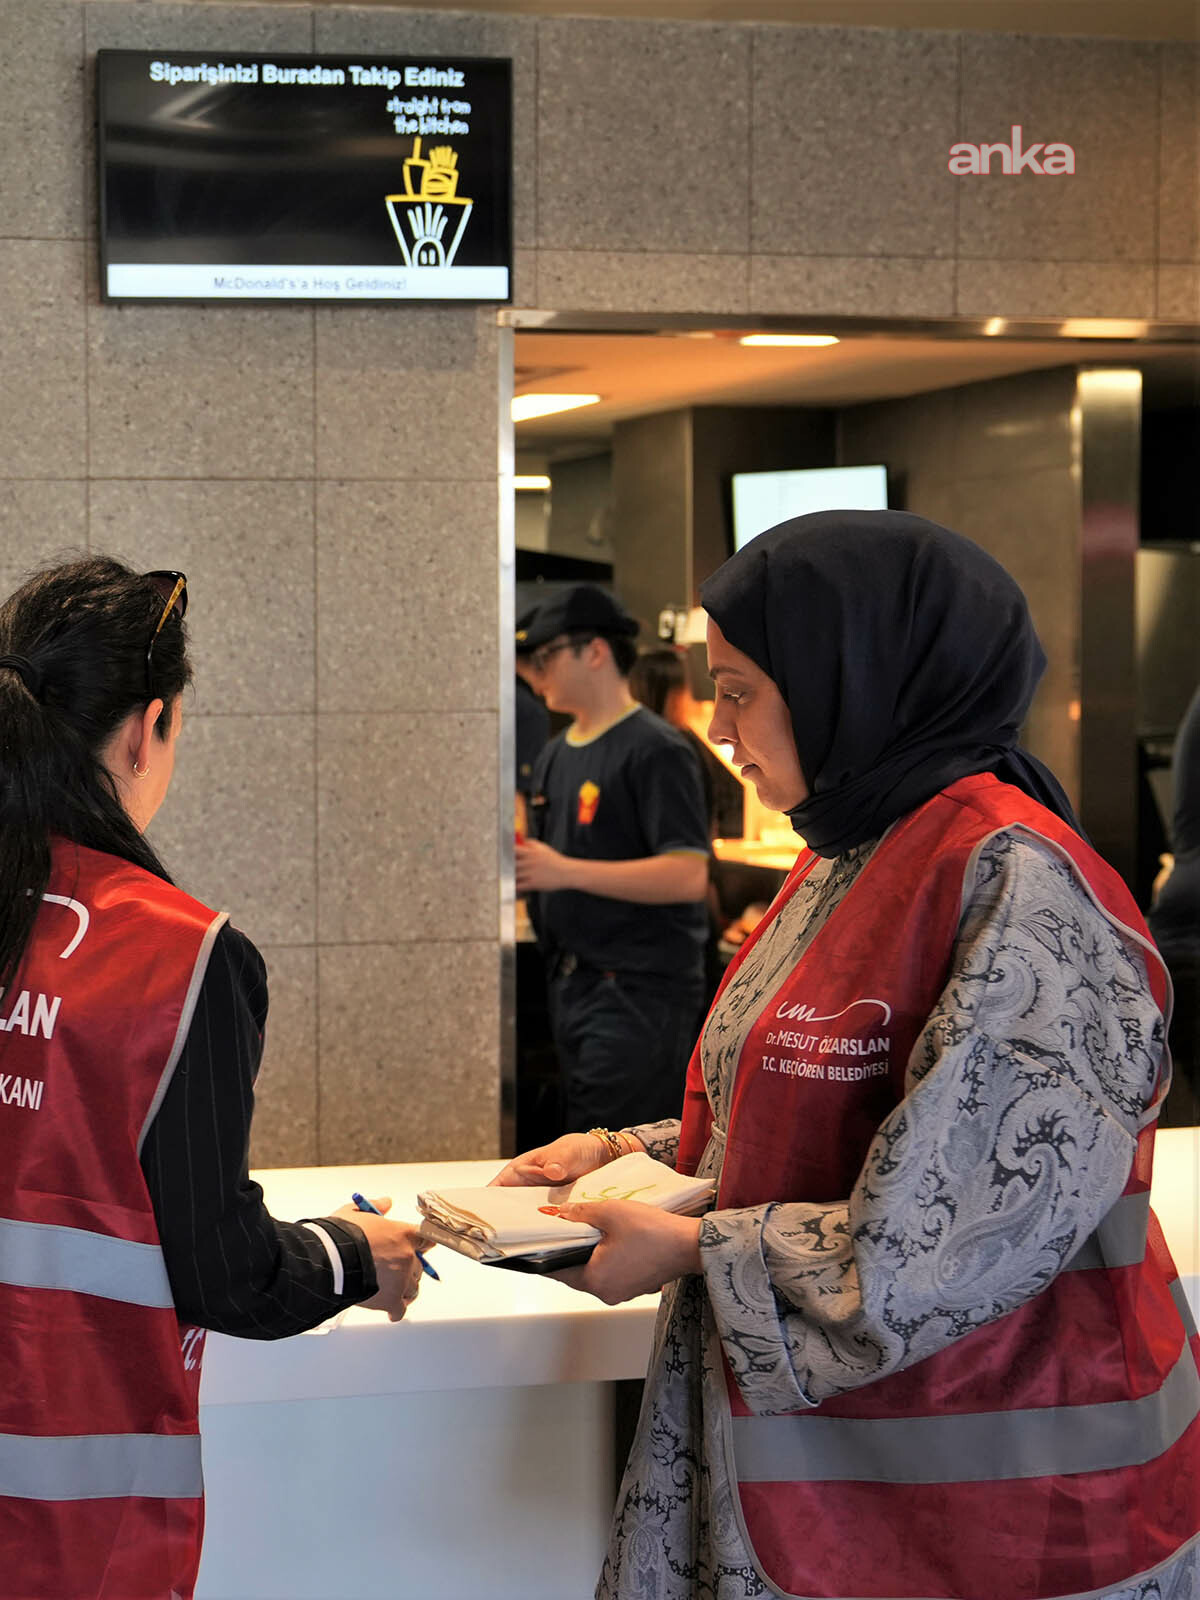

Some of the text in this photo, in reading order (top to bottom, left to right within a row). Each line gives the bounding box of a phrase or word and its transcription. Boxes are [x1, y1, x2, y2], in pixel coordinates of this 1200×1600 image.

[149, 61, 466, 90] Siparişinizi Buradan Takip Ediniz
[765, 1030, 890, 1056] Dr.MESUT ÖZARSLAN
[762, 1055, 889, 1082] T.C. KEÇİÖREN BELEDİYESİ
